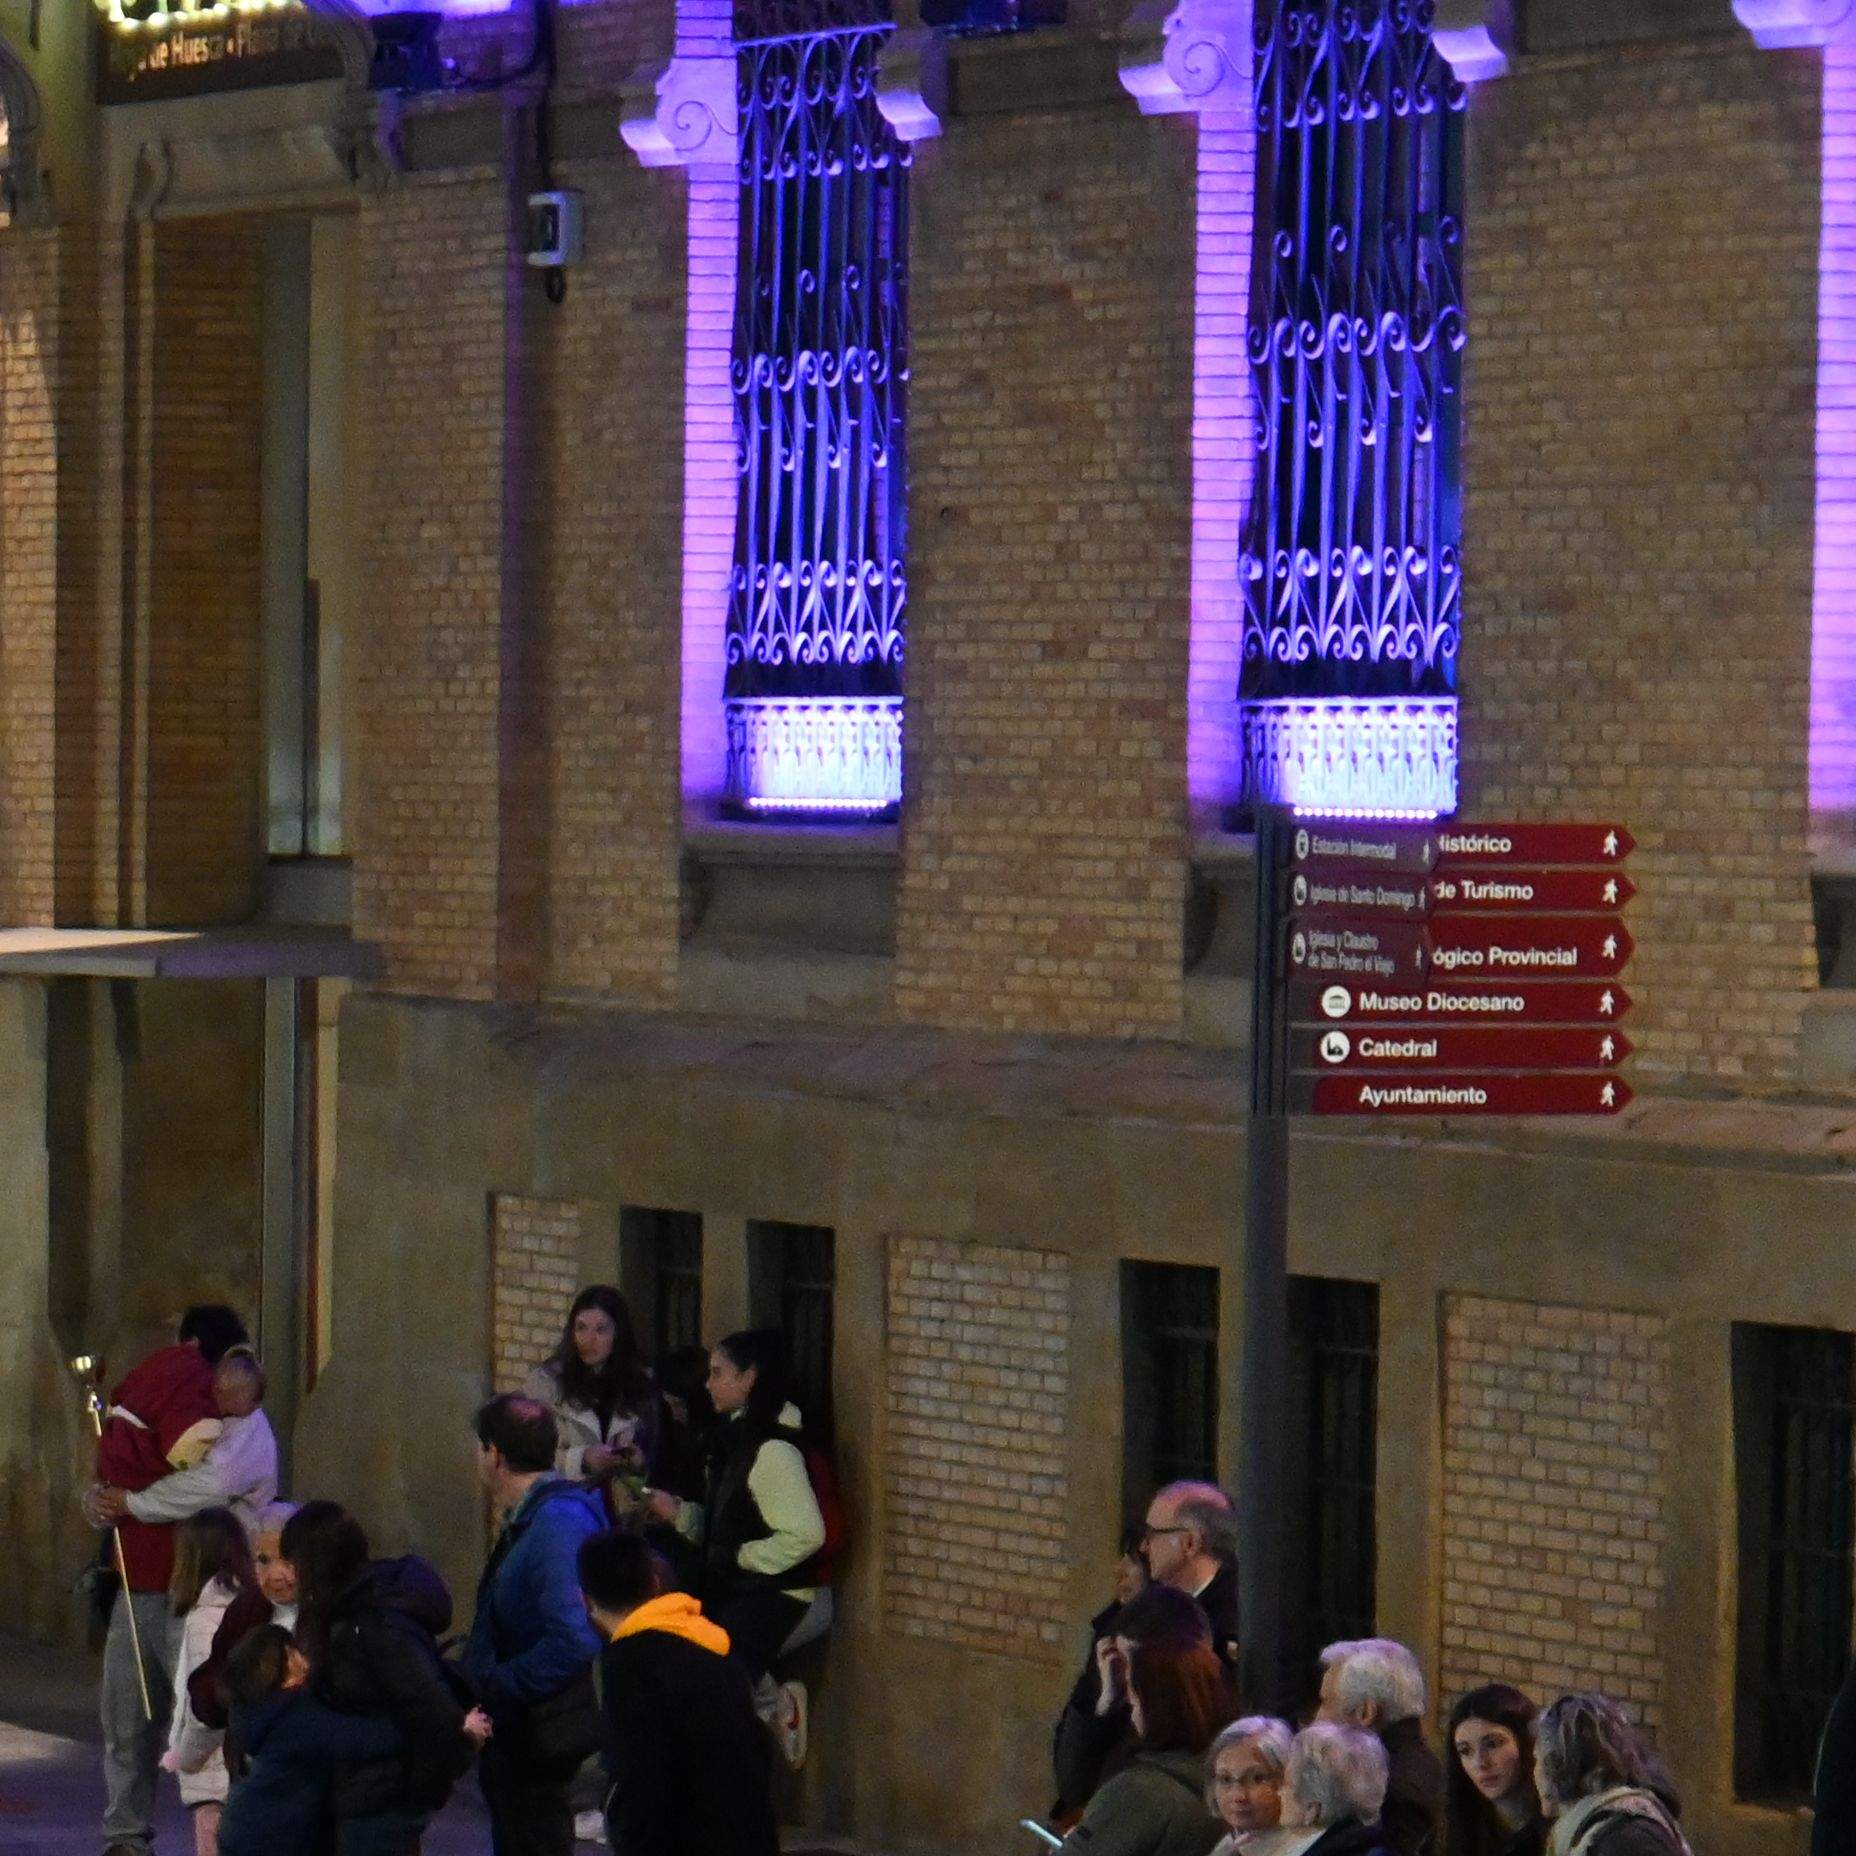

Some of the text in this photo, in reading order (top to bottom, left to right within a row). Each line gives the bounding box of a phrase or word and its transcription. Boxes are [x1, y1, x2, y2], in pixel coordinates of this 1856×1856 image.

[1460, 879, 1535, 901] Turismo
[1488, 946, 1578, 967] Provincial
[1359, 992, 1525, 1012] Museo Diocesano
[1358, 1037, 1438, 1058] Catedral
[1358, 1085, 1488, 1108] Ayuntamiento
